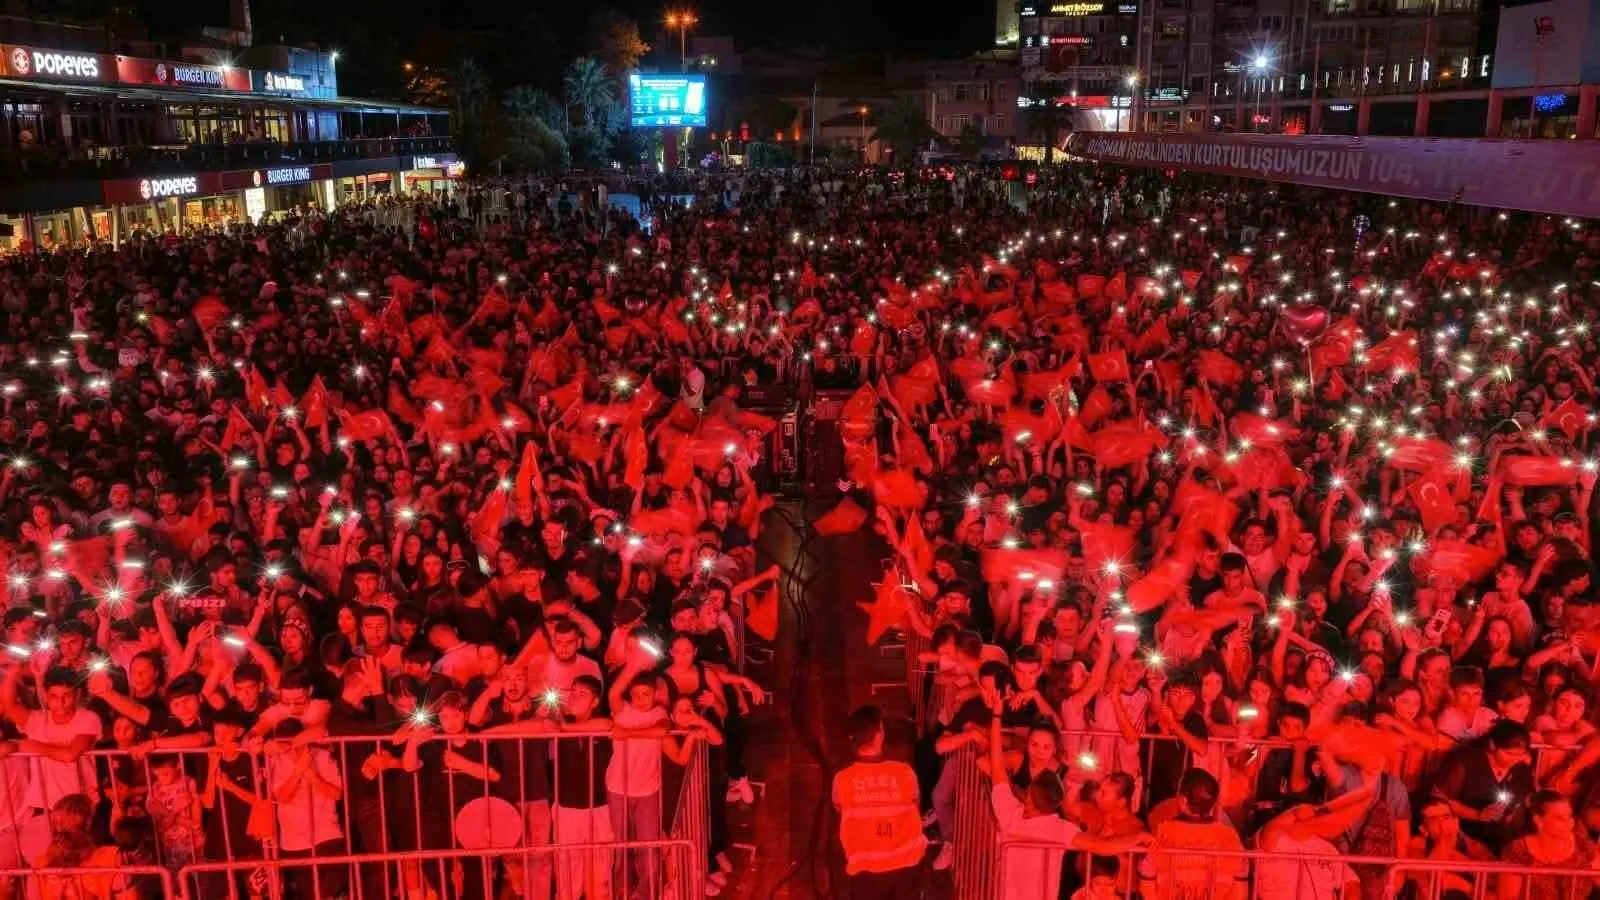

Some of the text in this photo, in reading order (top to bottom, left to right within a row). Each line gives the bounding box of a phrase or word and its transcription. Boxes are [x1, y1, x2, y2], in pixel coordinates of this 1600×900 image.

[174, 67, 206, 83] BURGER
[1194, 143, 1364, 180] KURTULUŞUMUZUN
[268, 168, 310, 183] BURGER KING
